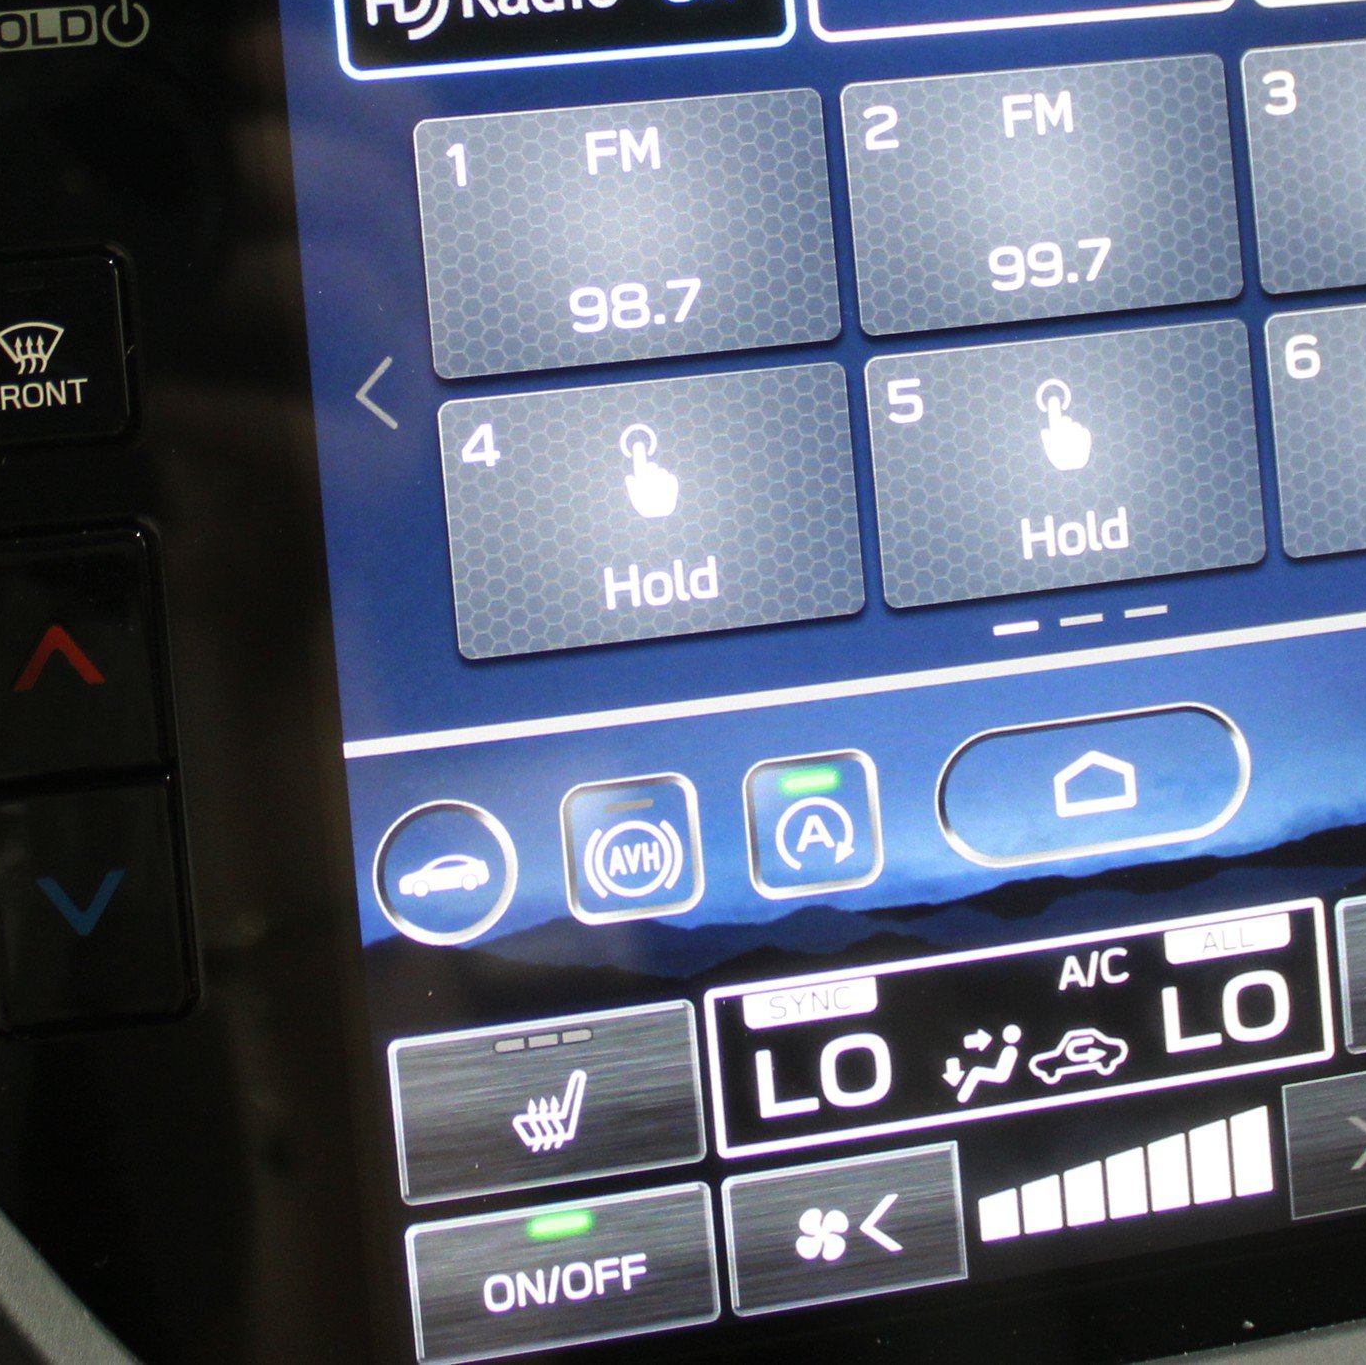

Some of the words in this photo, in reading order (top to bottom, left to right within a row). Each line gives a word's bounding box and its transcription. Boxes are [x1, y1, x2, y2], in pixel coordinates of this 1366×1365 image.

[1000, 90, 1075, 139] FM
[1261, 70, 1298, 117] 3
[584, 125, 662, 176] FM
[862, 104, 900, 152] 2
[445, 142, 469, 188] 1
[987, 237, 1113, 292] 99.7
[568, 277, 703, 334] 98.7
[1283, 334, 1322, 380] 6
[886, 377, 925, 425] 5
[460, 423, 501, 468] 4
[1019, 507, 1131, 562] Hold
[602, 555, 720, 611] Hold
[607, 841, 663, 877] AVH
[1201, 928, 1255, 954] ALL
[1058, 945, 1132, 992] A/C
[768, 985, 855, 1021] SYNC
[1160, 969, 1292, 1054] LO
[753, 1031, 893, 1121] LO
[481, 1252, 648, 1315] ON/OFF
